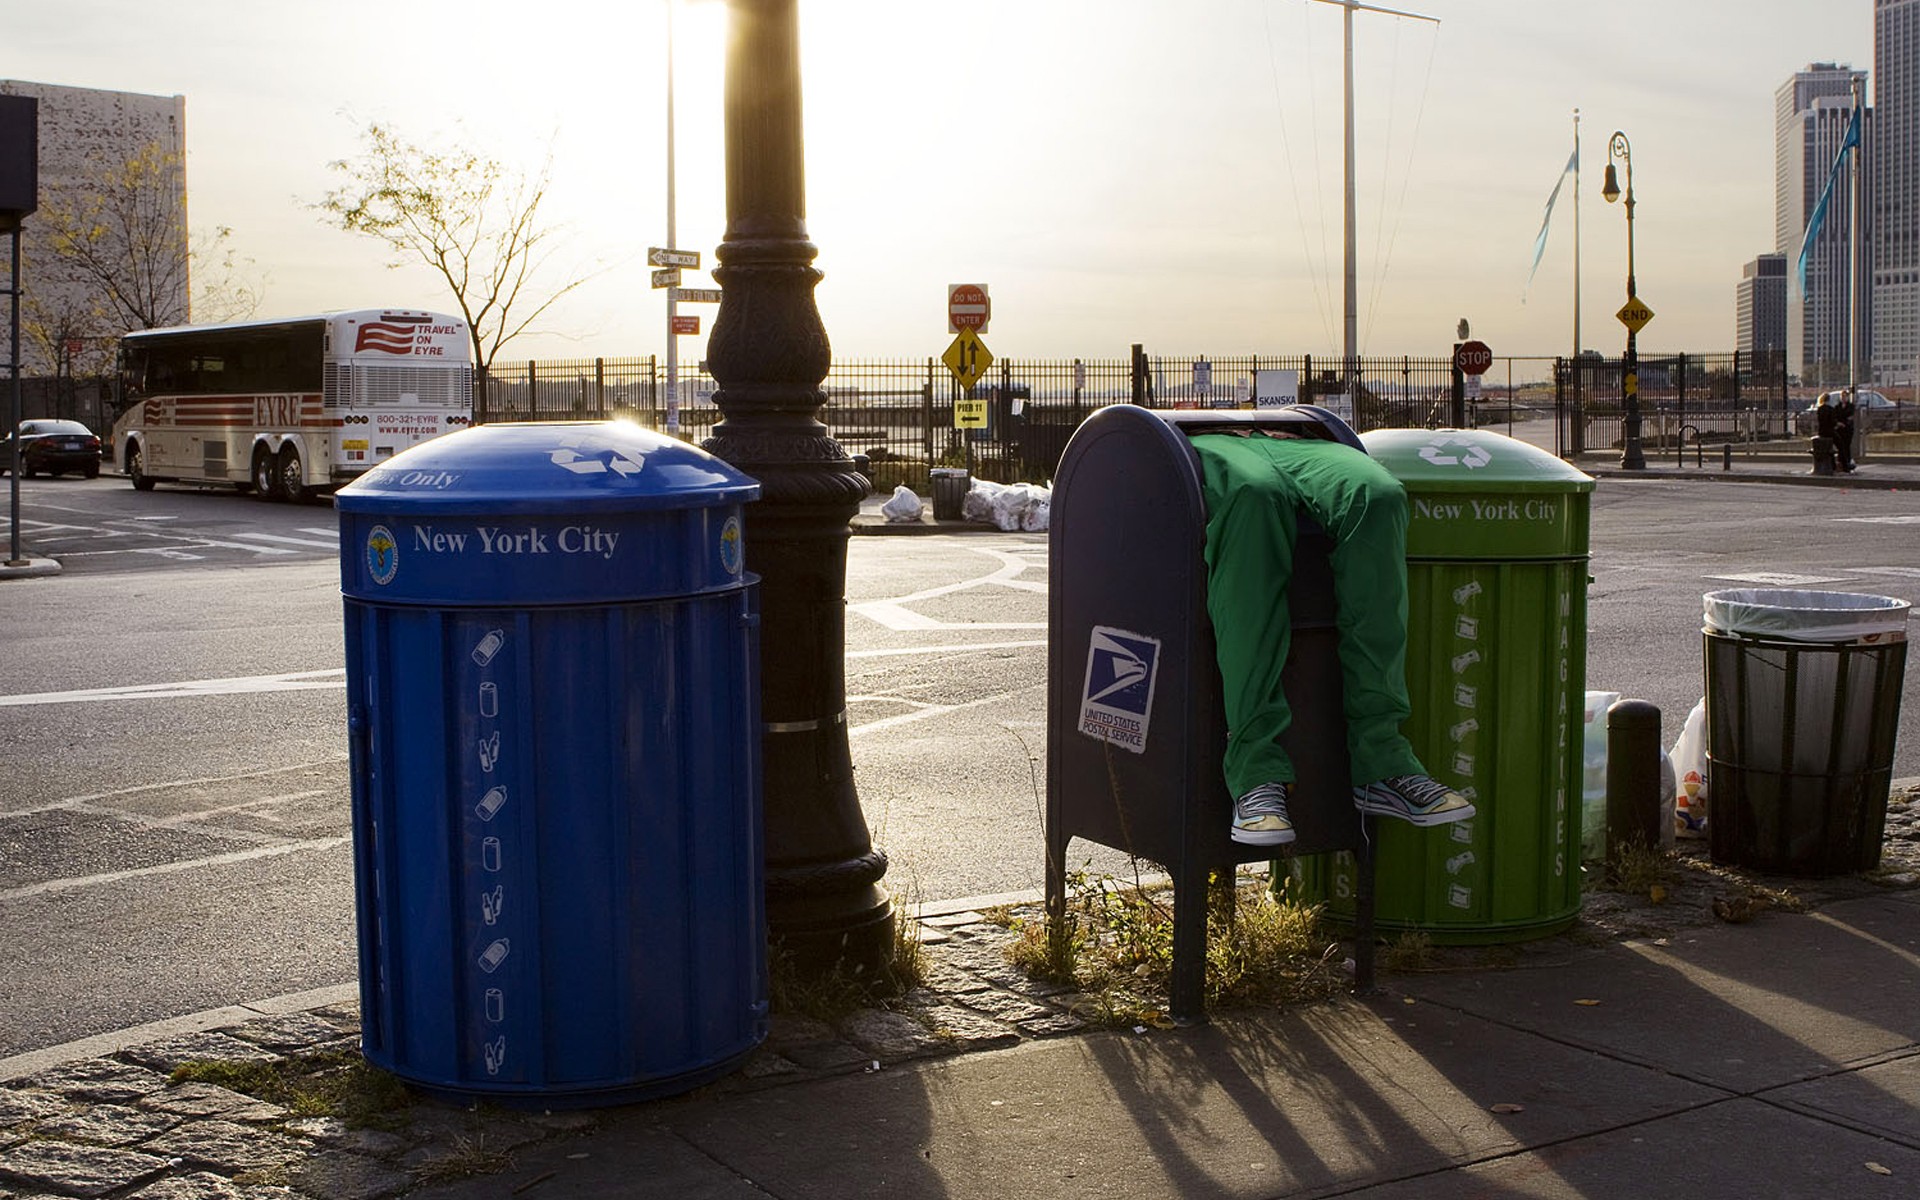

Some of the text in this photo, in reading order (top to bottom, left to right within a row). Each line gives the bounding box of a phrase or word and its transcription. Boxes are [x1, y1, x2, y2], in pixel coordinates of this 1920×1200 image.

[677, 256, 694, 264] WAY
[954, 294, 982, 302] DO NOT
[956, 315, 980, 325] ENTER
[1622, 309, 1649, 321] END
[418, 325, 456, 335] TRAVEL
[416, 335, 432, 345] ON
[414, 346, 444, 356] EYRE
[1459, 351, 1491, 366] STOP
[1258, 395, 1297, 407] SKANSKA
[254, 395, 300, 427] EYRE
[957, 403, 982, 412] PIER 11
[376, 415, 439, 424] 800-321-EYRE
[378, 425, 437, 435] www.eyre.com
[400, 471, 460, 489] Only
[1414, 499, 1558, 525] New York City
[413, 525, 620, 559] New York City
[1084, 708, 1141, 732] UNITED STATES
[1082, 721, 1142, 746] POSTAL SERVICE
[1555, 592, 1570, 876] MAGAZINES
